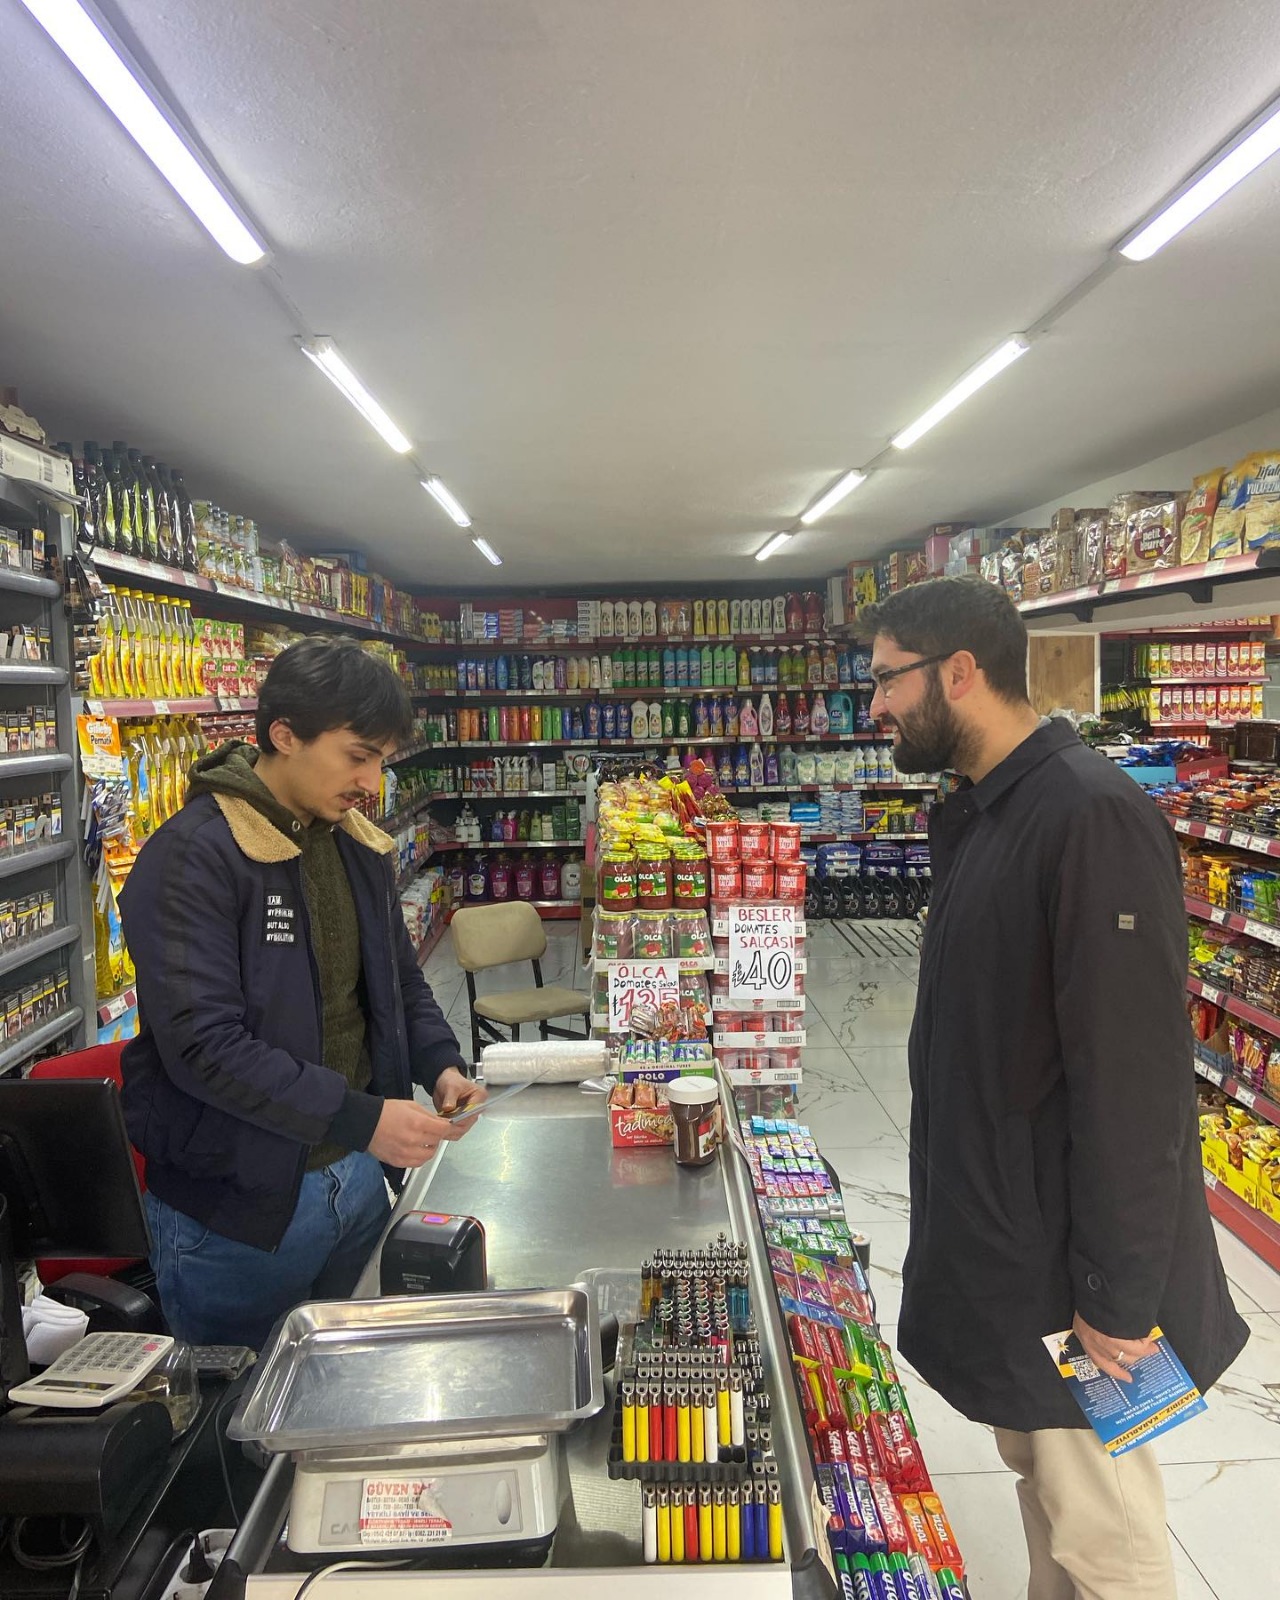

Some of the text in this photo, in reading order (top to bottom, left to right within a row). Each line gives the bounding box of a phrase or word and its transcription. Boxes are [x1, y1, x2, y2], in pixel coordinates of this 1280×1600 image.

[614, 875, 631, 883] OLCA
[738, 908, 793, 922] BESLER
[734, 923, 778, 934] DOMATES
[690, 932, 707, 940] OLCA
[740, 936, 793, 949] SALÇASI
[618, 966, 667, 979] OLCA
[614, 978, 656, 989] Domates
[638, 1072, 665, 1080] POLO
[367, 1481, 409, 1496] GÜVEN
